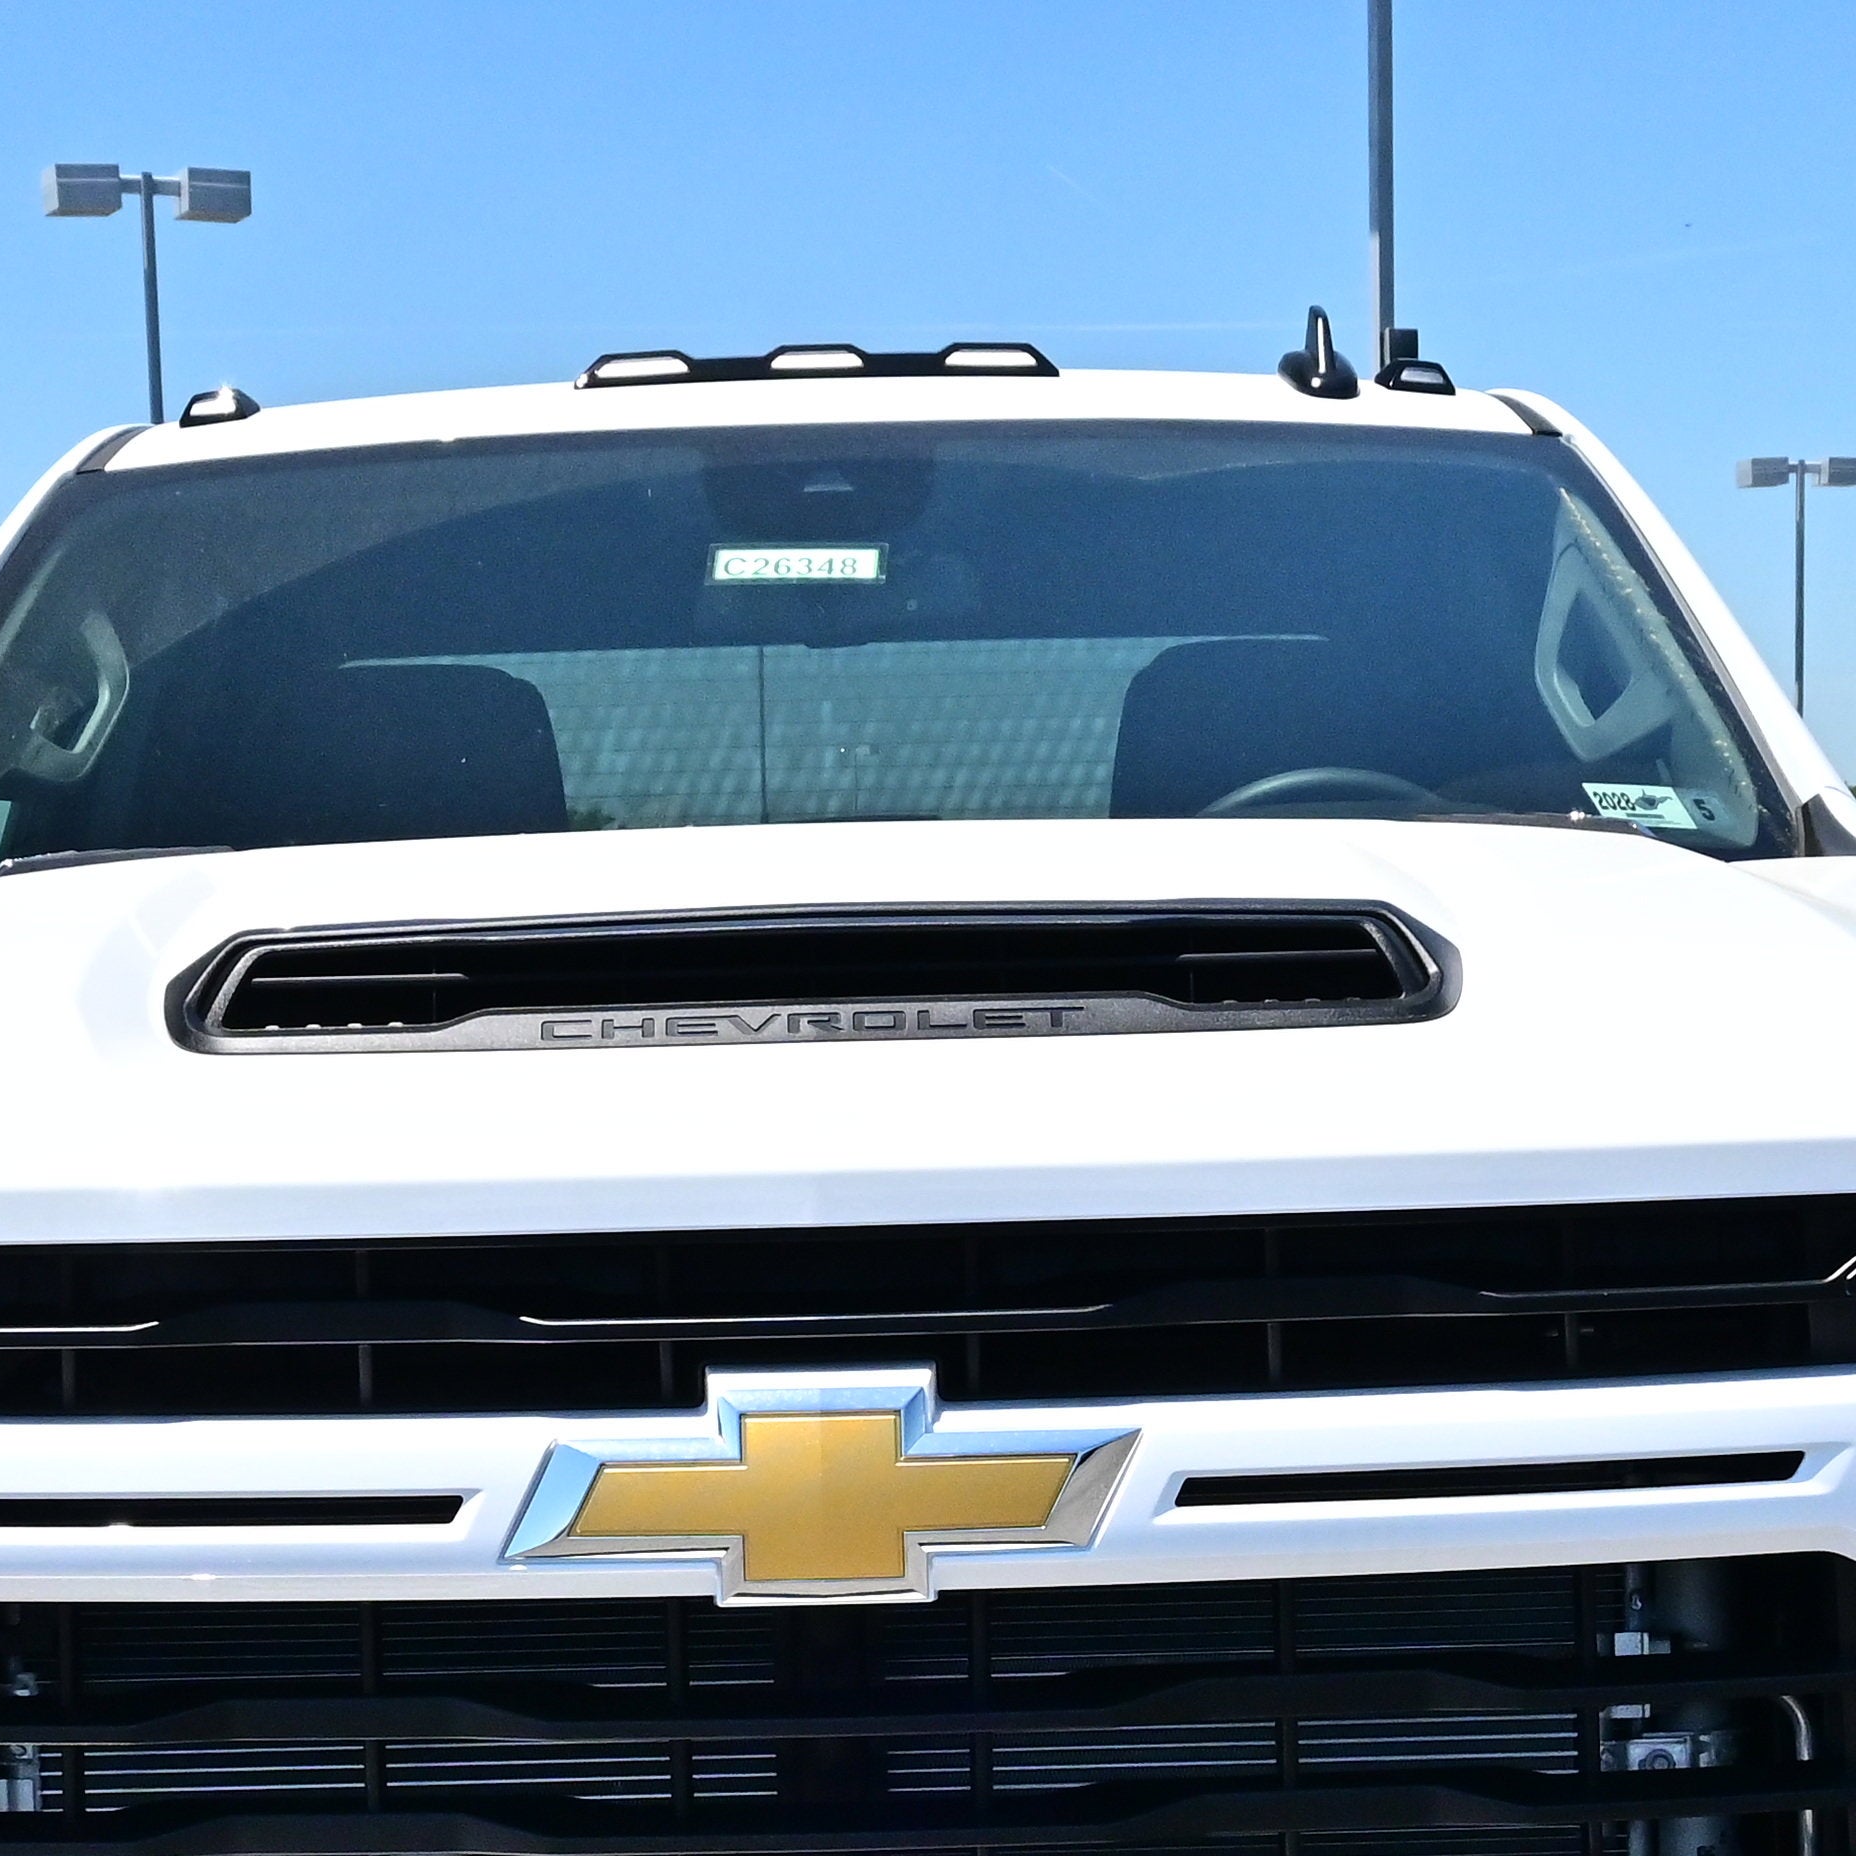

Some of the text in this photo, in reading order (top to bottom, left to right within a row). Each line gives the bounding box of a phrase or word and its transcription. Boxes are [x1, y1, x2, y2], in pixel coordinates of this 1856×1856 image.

[723, 556, 858, 577] C26348
[1593, 791, 1715, 821] 2028 5
[540, 1005, 1086, 1042] CHEVROLET
